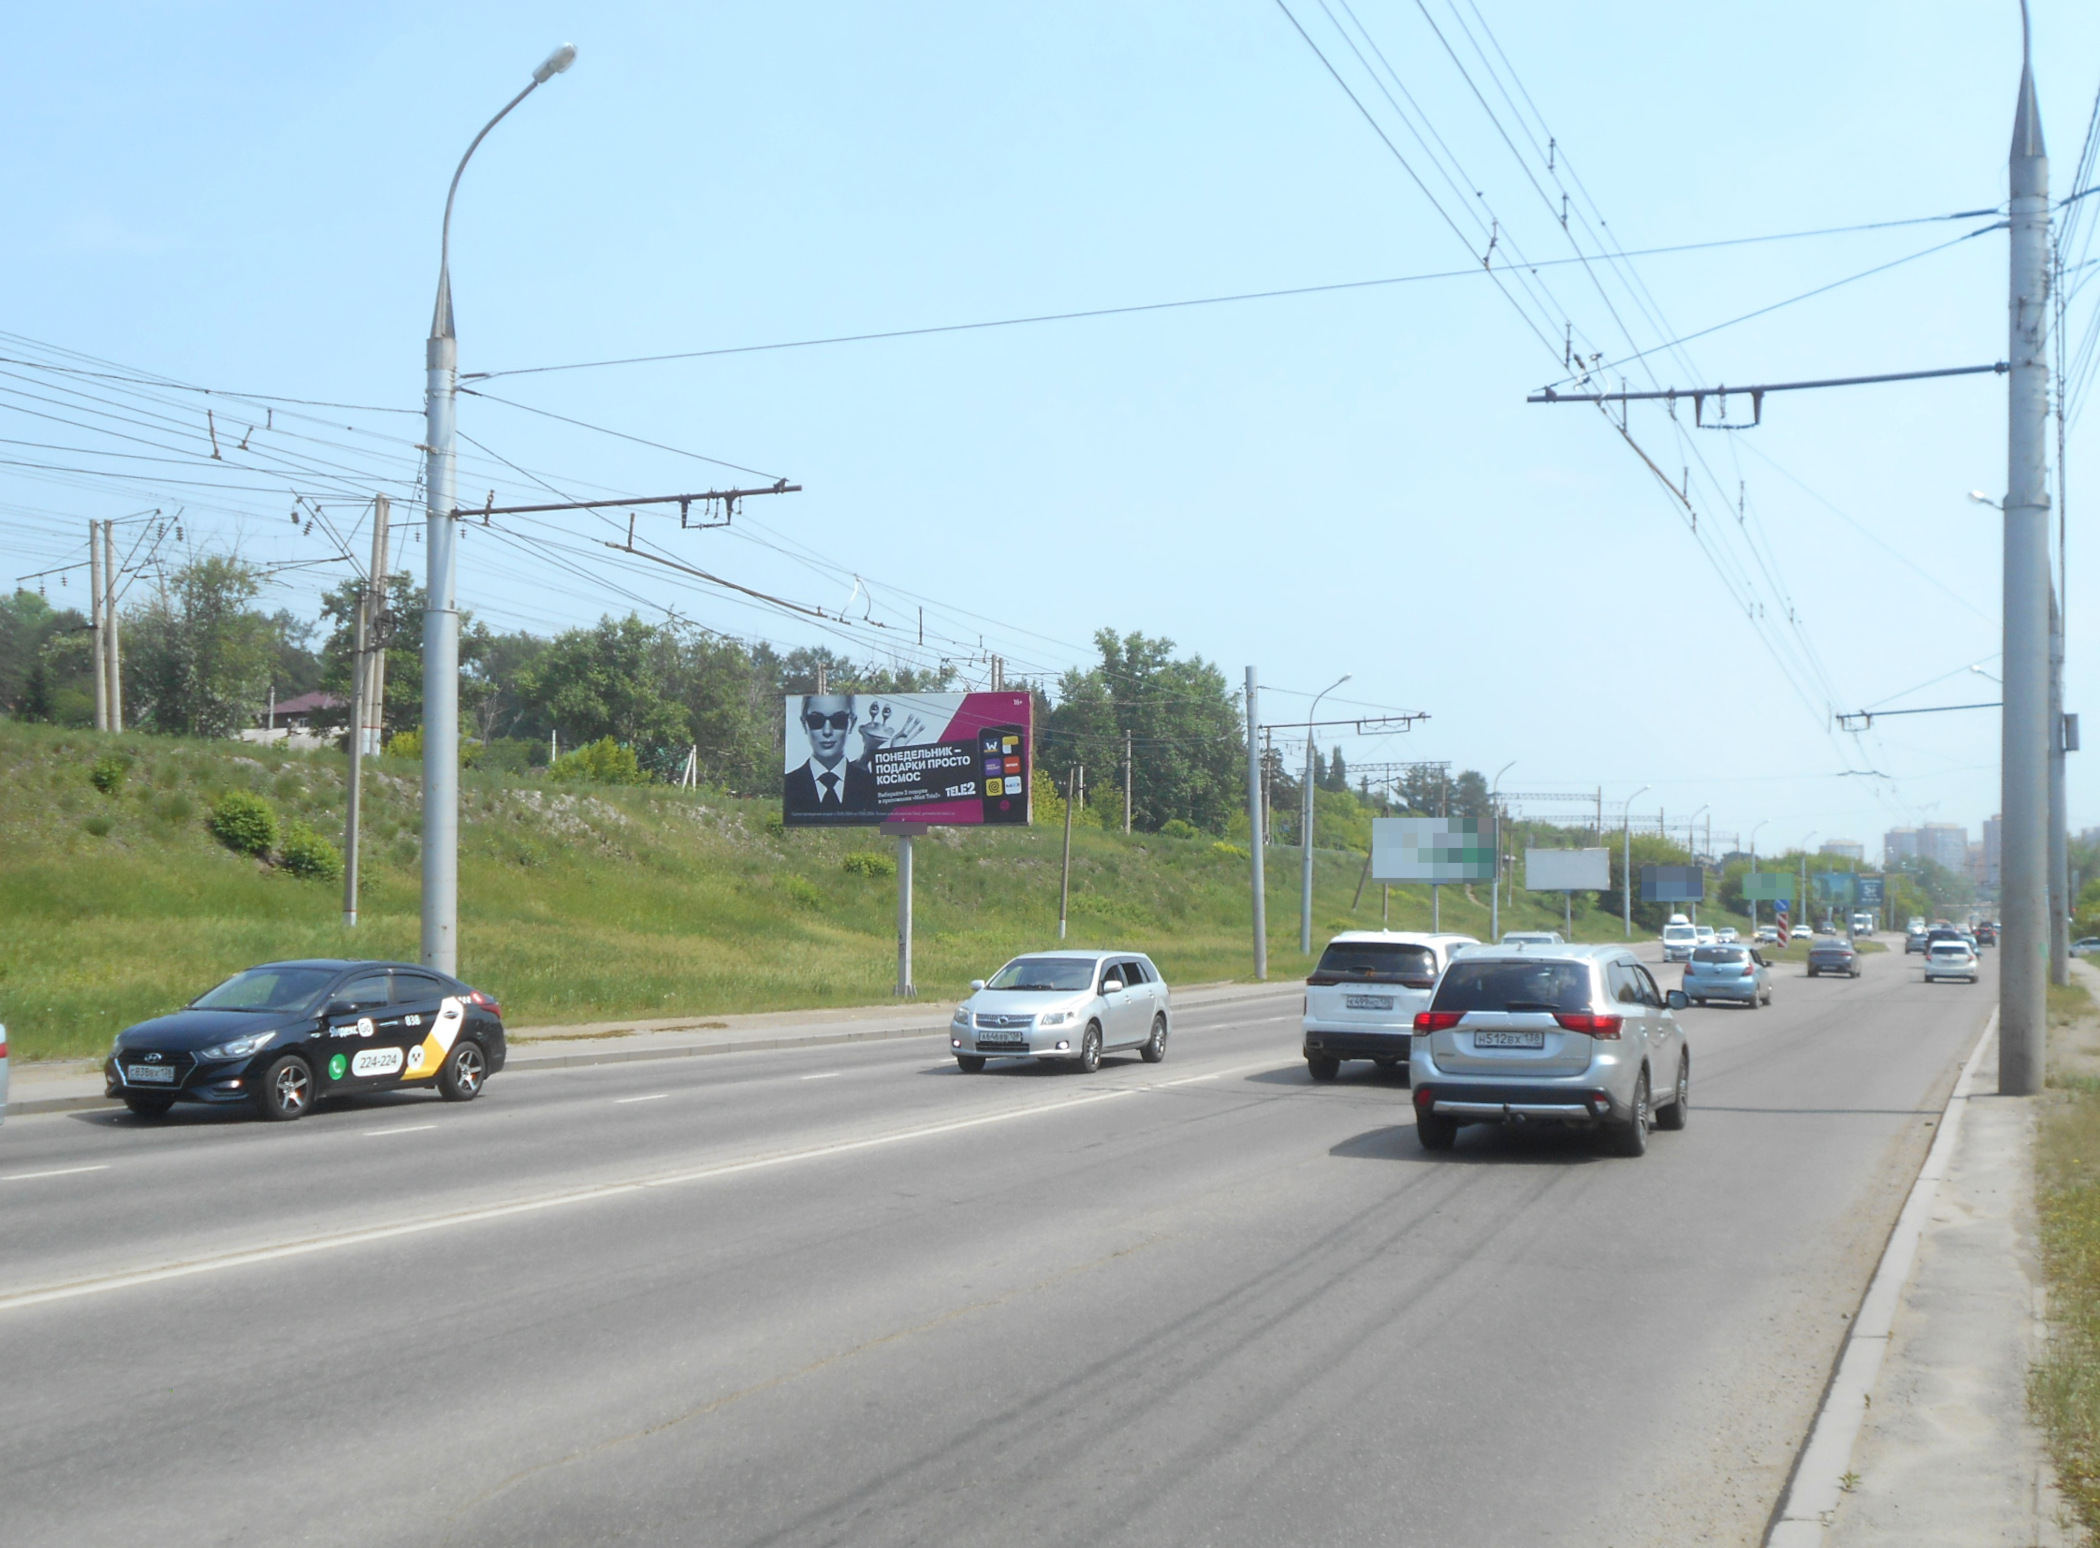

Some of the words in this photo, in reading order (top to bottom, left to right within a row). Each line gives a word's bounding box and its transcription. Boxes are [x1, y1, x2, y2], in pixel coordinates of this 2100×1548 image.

[875, 746, 953, 764] ПОНЕДЕЛЬНИК
[875, 761, 926, 774] ПОДАРКИ
[927, 756, 971, 769] ПРОСТО
[876, 772, 921, 785] КОСМОС
[945, 781, 976, 797] TELE2
[404, 1014, 422, 1026] 838
[329, 1025, 358, 1038] Яндекс
[359, 1022, 371, 1033] Go
[1478, 1033, 1522, 1045] Н512ВХ
[1524, 1034, 1540, 1042] 138
[359, 1054, 398, 1069] 224-224
